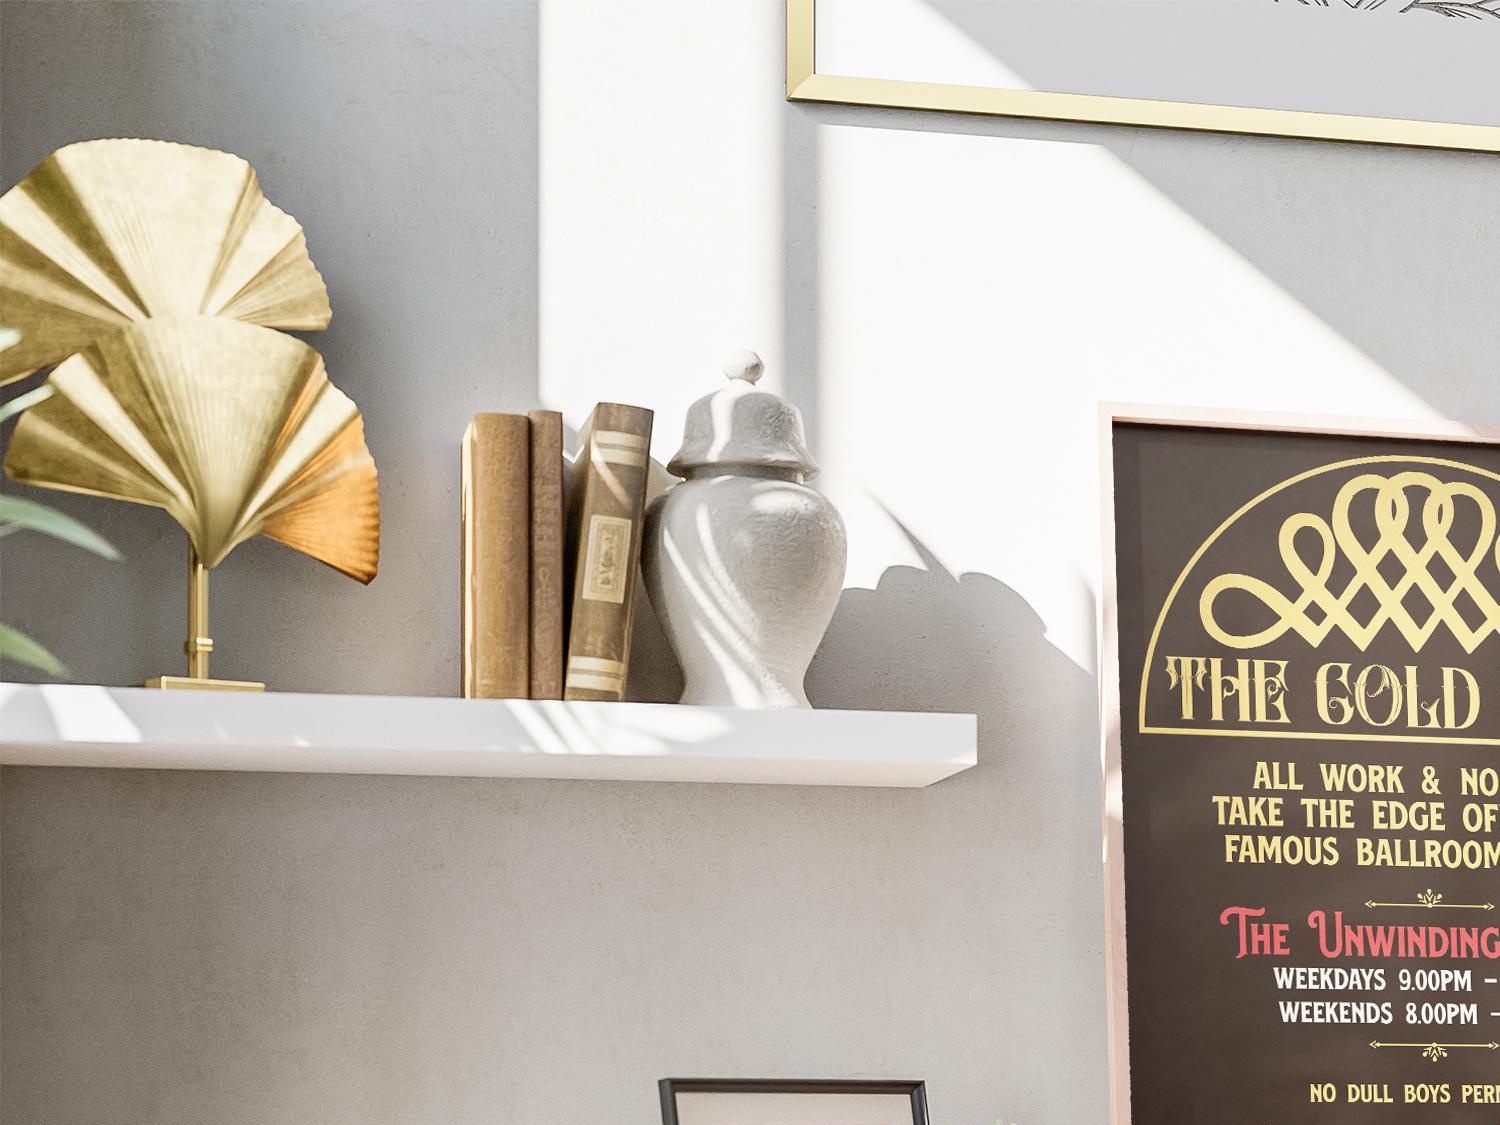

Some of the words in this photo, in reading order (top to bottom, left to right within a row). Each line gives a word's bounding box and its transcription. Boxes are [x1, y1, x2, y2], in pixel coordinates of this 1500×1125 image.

[1165, 655, 1292, 724] THE
[1313, 662, 1481, 730] GOLD
[1252, 761, 1305, 791] ALL
[1318, 763, 1405, 794] WORK
[1421, 765, 1443, 795] &
[1460, 767, 1500, 797] NO
[1211, 795, 1284, 827] TAKE
[1300, 797, 1356, 829] THE
[1371, 800, 1446, 832] EDGE
[1224, 834, 1340, 866] FAMOUS
[1272, 966, 1387, 991] WEEKDAYS
[1398, 968, 1473, 992] 9.00PM
[1278, 1000, 1394, 1025] WEEKENDS
[1405, 1002, 1479, 1025] 8.00PM
[1309, 1082, 1337, 1103] NO
[1347, 1083, 1394, 1103] DULL
[1403, 1083, 1451, 1104] BOYS
